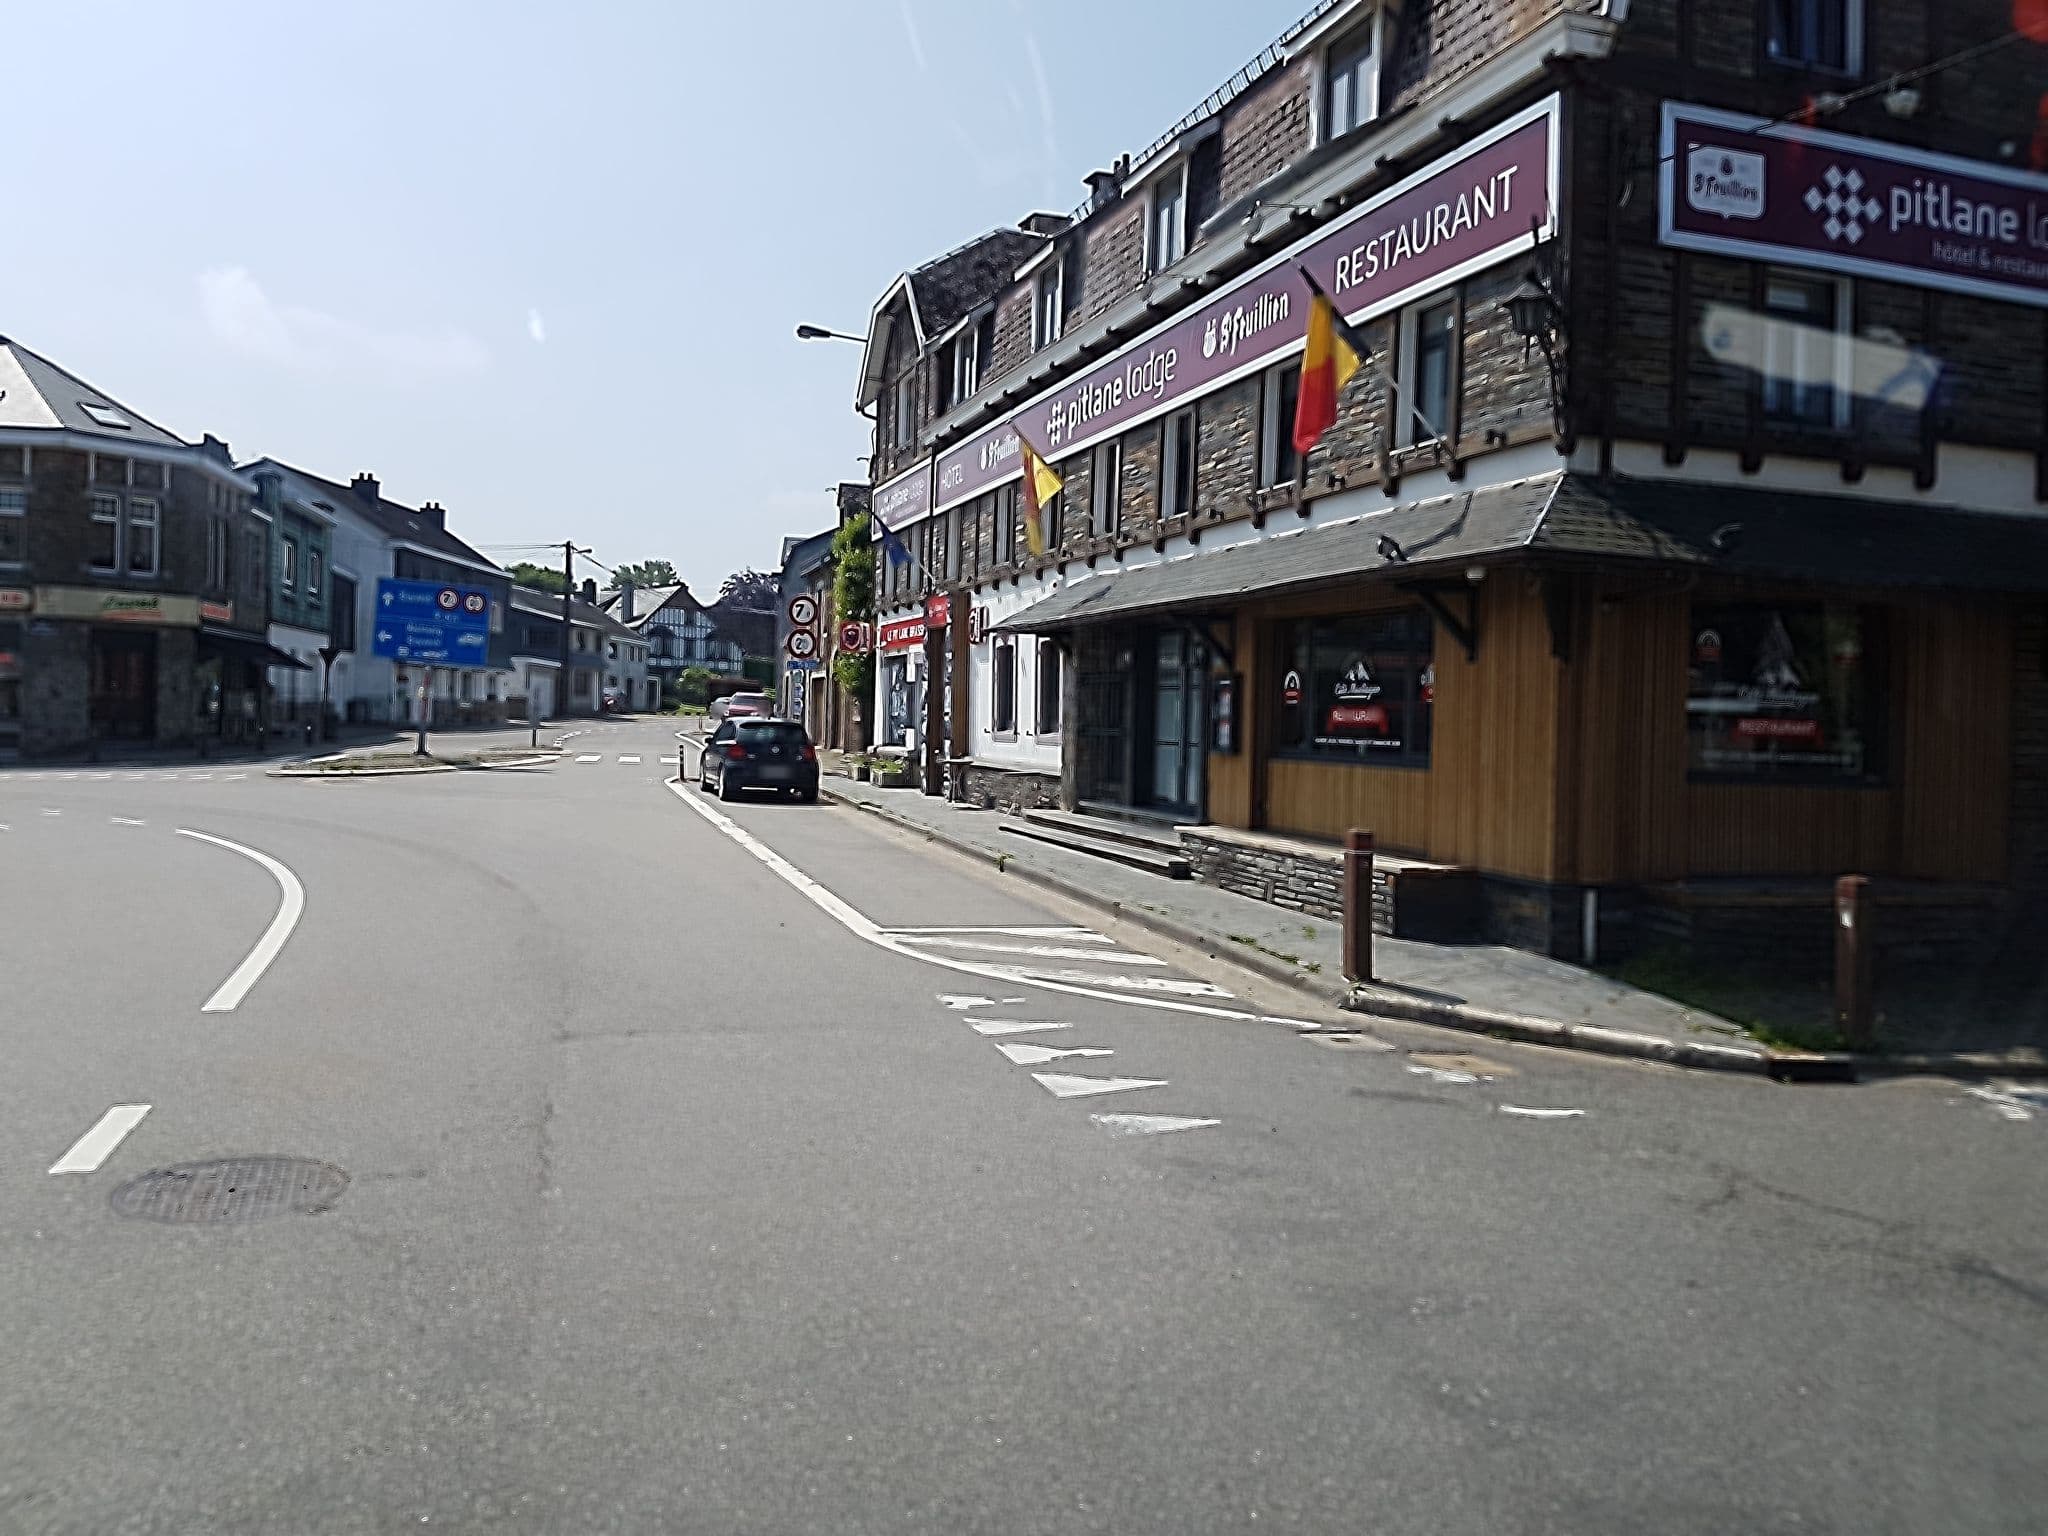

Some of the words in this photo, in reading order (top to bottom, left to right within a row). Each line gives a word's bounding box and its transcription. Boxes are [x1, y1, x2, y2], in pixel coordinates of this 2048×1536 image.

[1335, 165, 1518, 295] RESTAURANT
[1889, 178, 2019, 242] pitlane
[1067, 377, 1123, 440] pitlane
[1126, 348, 1177, 400] lodge
